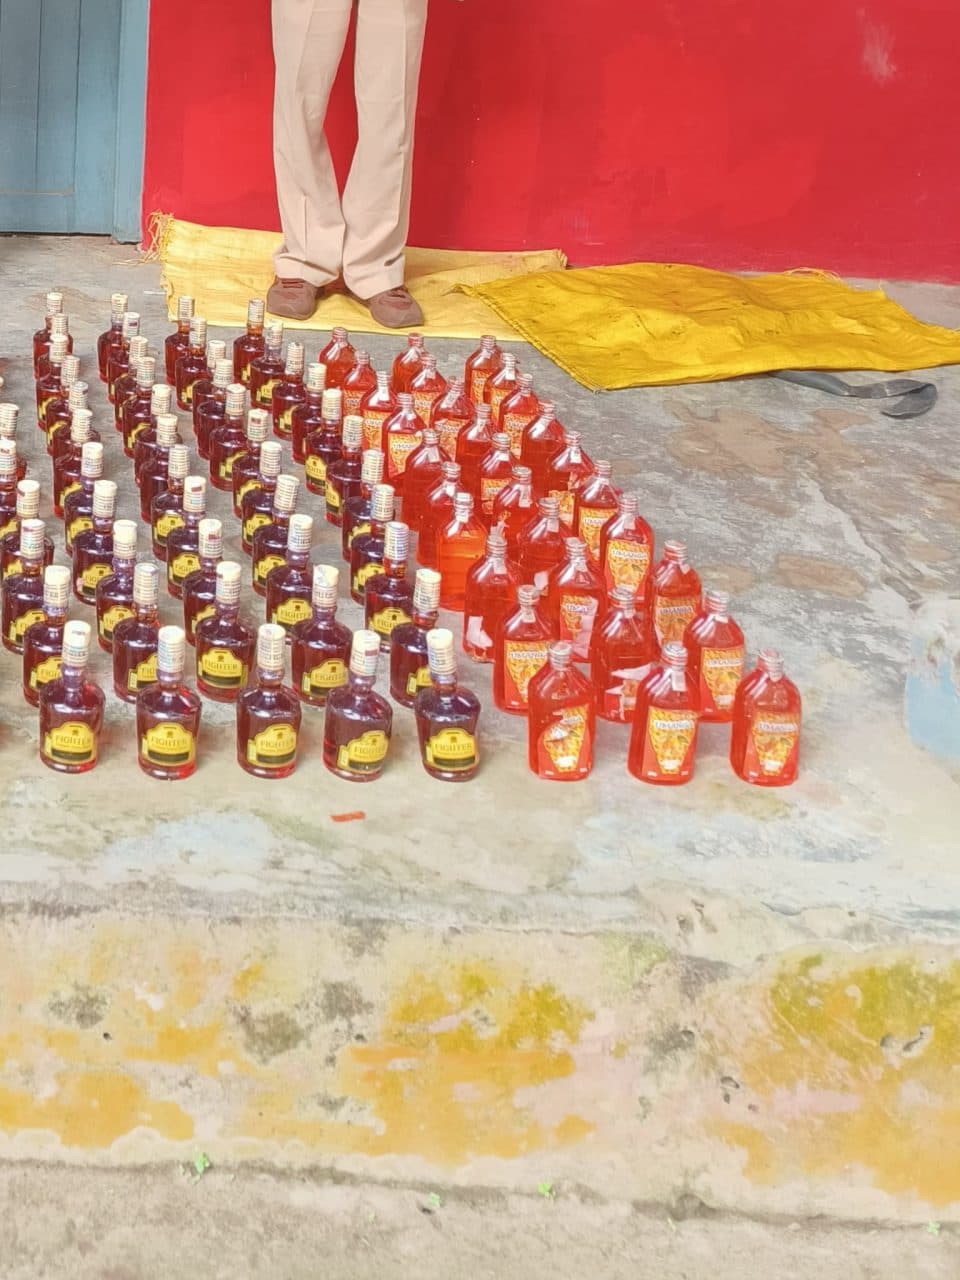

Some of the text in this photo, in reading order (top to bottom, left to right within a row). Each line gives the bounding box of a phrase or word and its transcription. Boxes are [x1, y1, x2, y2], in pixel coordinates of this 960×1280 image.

[204, 660, 240, 671] FIGHTER
[150, 734, 188, 746] FIGHTER
[433, 742, 473, 754] FIGHTER
